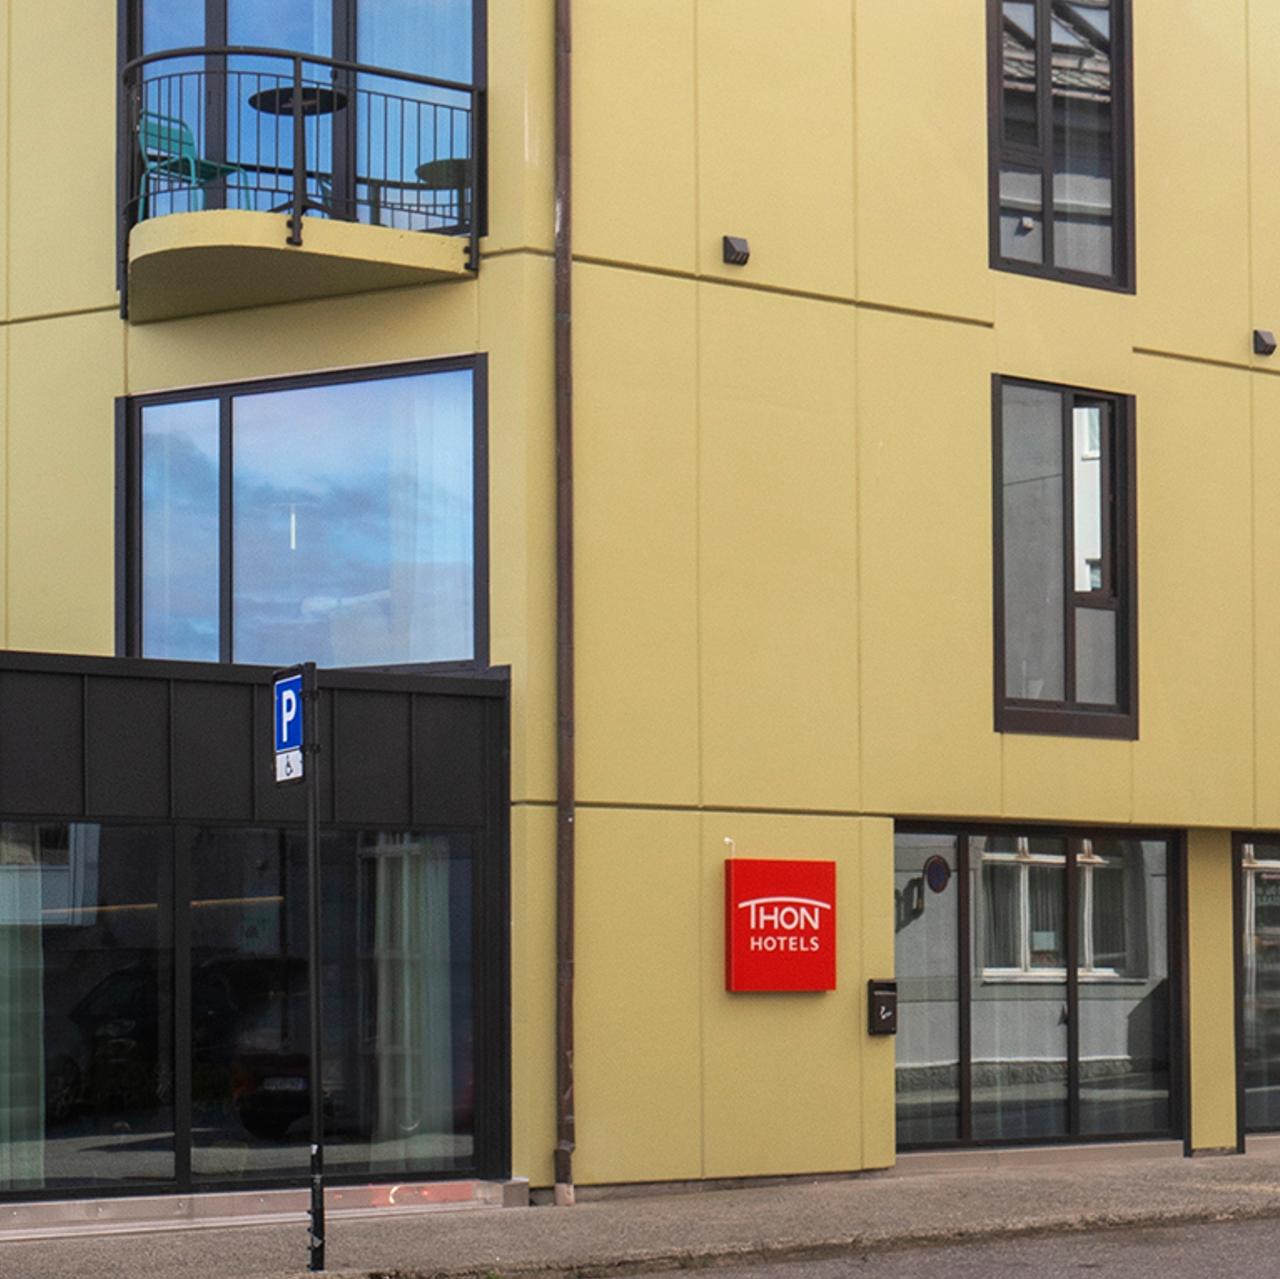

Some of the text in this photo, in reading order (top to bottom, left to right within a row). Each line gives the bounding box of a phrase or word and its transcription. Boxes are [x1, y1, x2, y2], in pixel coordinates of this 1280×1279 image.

[282, 689, 297, 743] P
[738, 896, 832, 930] THON
[750, 936, 820, 952] HOTELS
